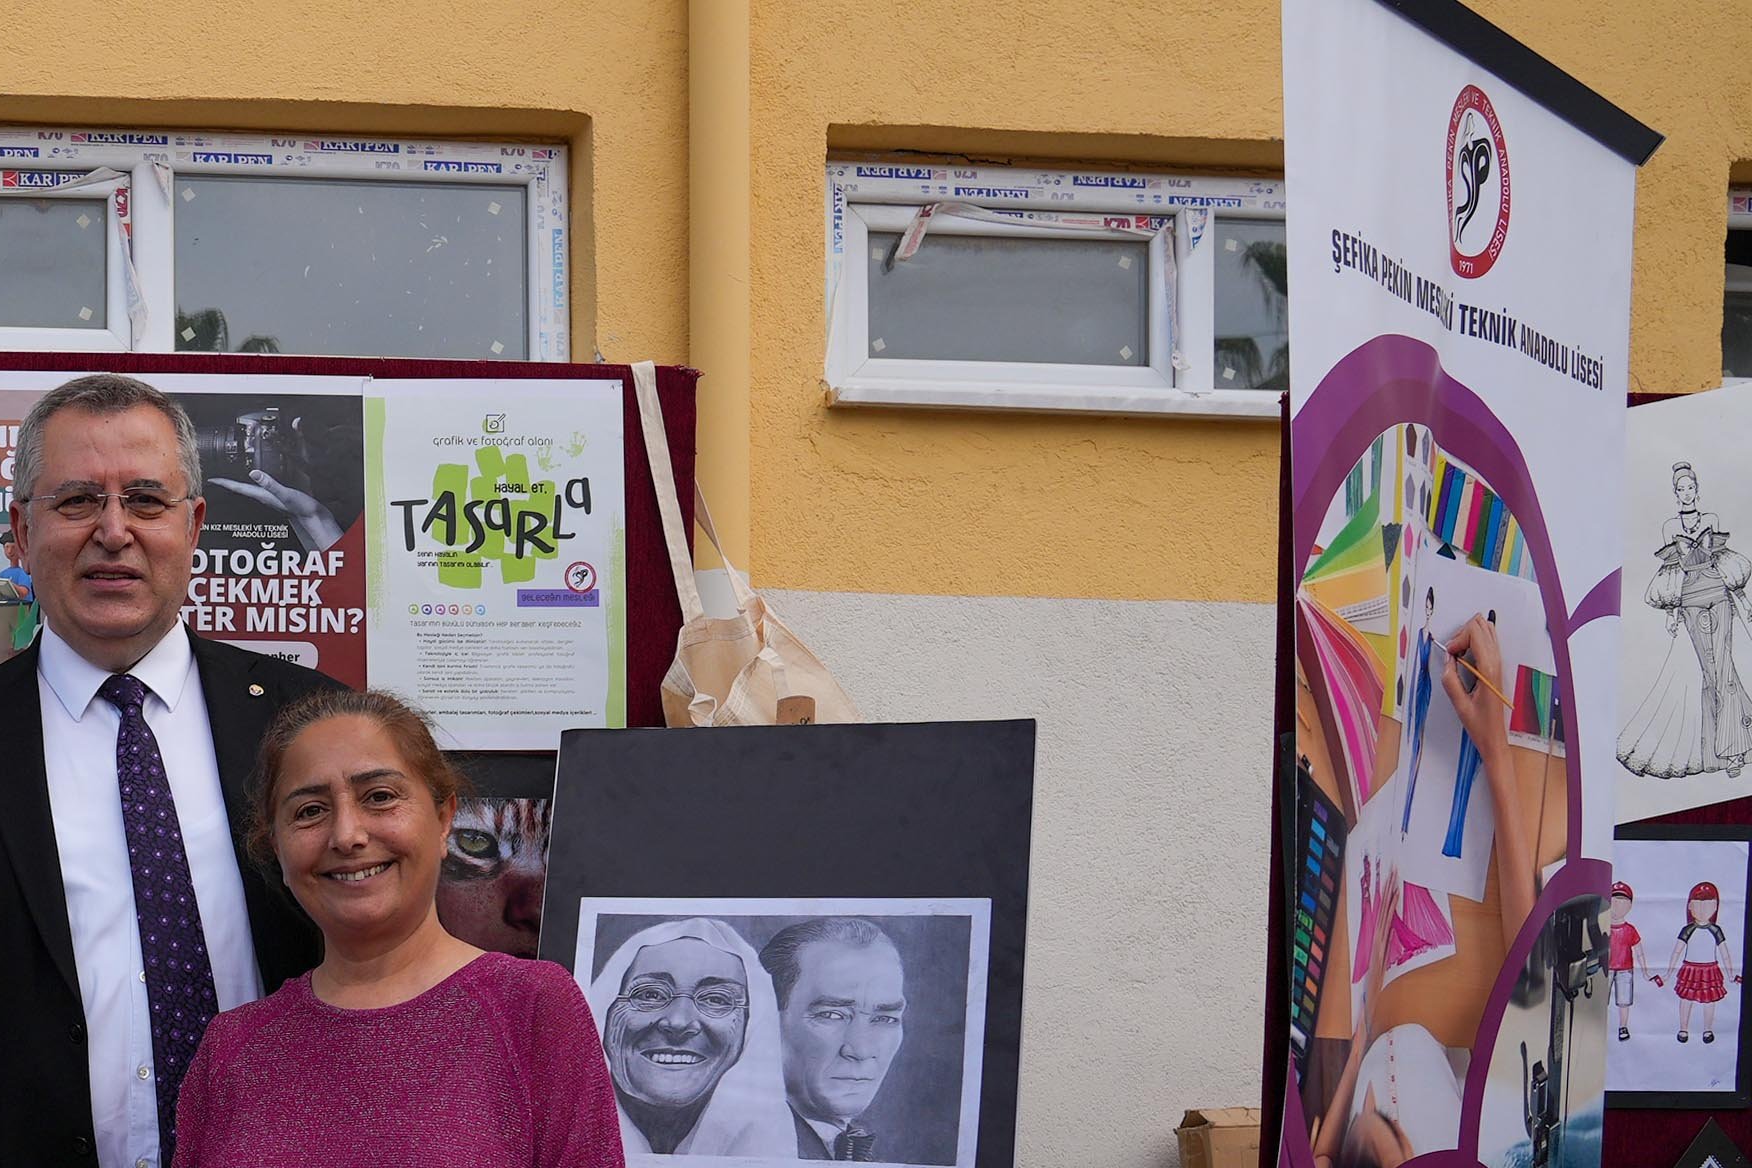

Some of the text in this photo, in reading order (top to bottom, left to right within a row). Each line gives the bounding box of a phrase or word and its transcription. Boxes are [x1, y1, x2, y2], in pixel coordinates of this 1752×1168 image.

[18, 171, 53, 187] KAR
[1496, 148, 1510, 213] ANADOLU
[1458, 260, 1474, 275] 1971
[1331, 229, 1380, 283] ŞEFİKA
[1381, 257, 1413, 305] PEKİN
[1459, 302, 1518, 350] TEKNİK
[1520, 324, 1569, 376] ANADOLU
[1571, 344, 1604, 392] LİSESİ
[432, 435, 554, 447] grafik ve fotoğraf alanı
[191, 542, 344, 576] OTOĞRAF
[188, 578, 323, 612] ÇEKMEK
[180, 600, 365, 635] TER MİSİN?
